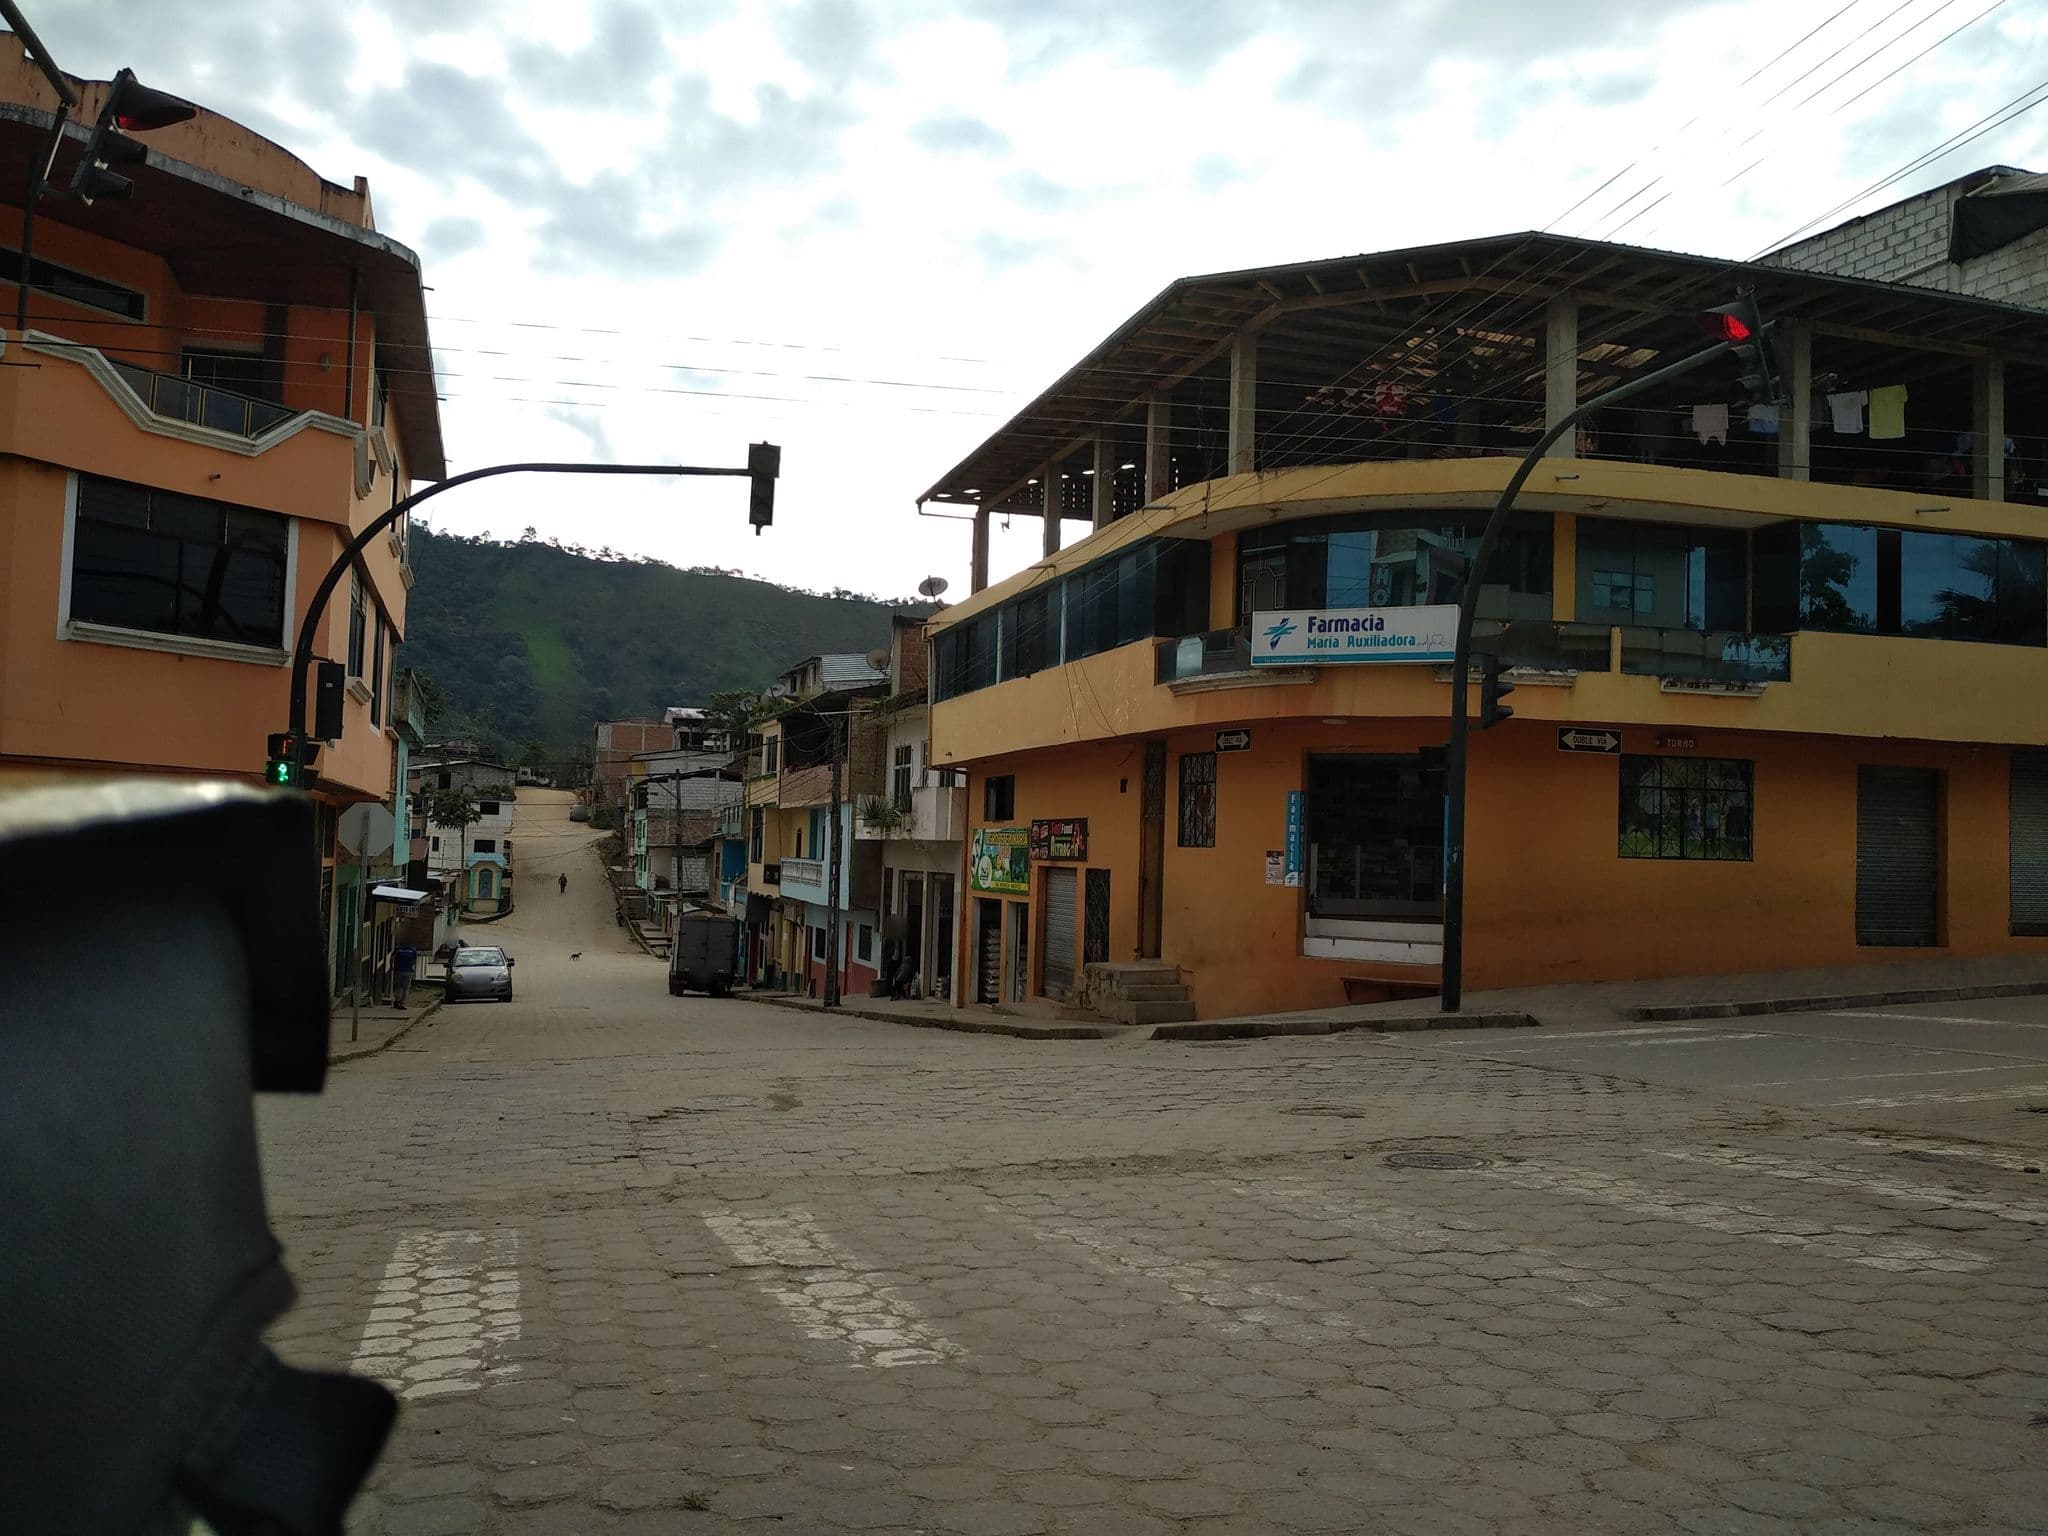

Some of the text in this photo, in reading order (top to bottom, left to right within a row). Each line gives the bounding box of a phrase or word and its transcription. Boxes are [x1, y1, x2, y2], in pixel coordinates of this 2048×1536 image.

[1307, 614, 1386, 634] Farmacia
[1347, 633, 1417, 648] Auxiliadora
[1573, 735, 1593, 745] DOBLE
[1288, 794, 1297, 872] Farmacia
